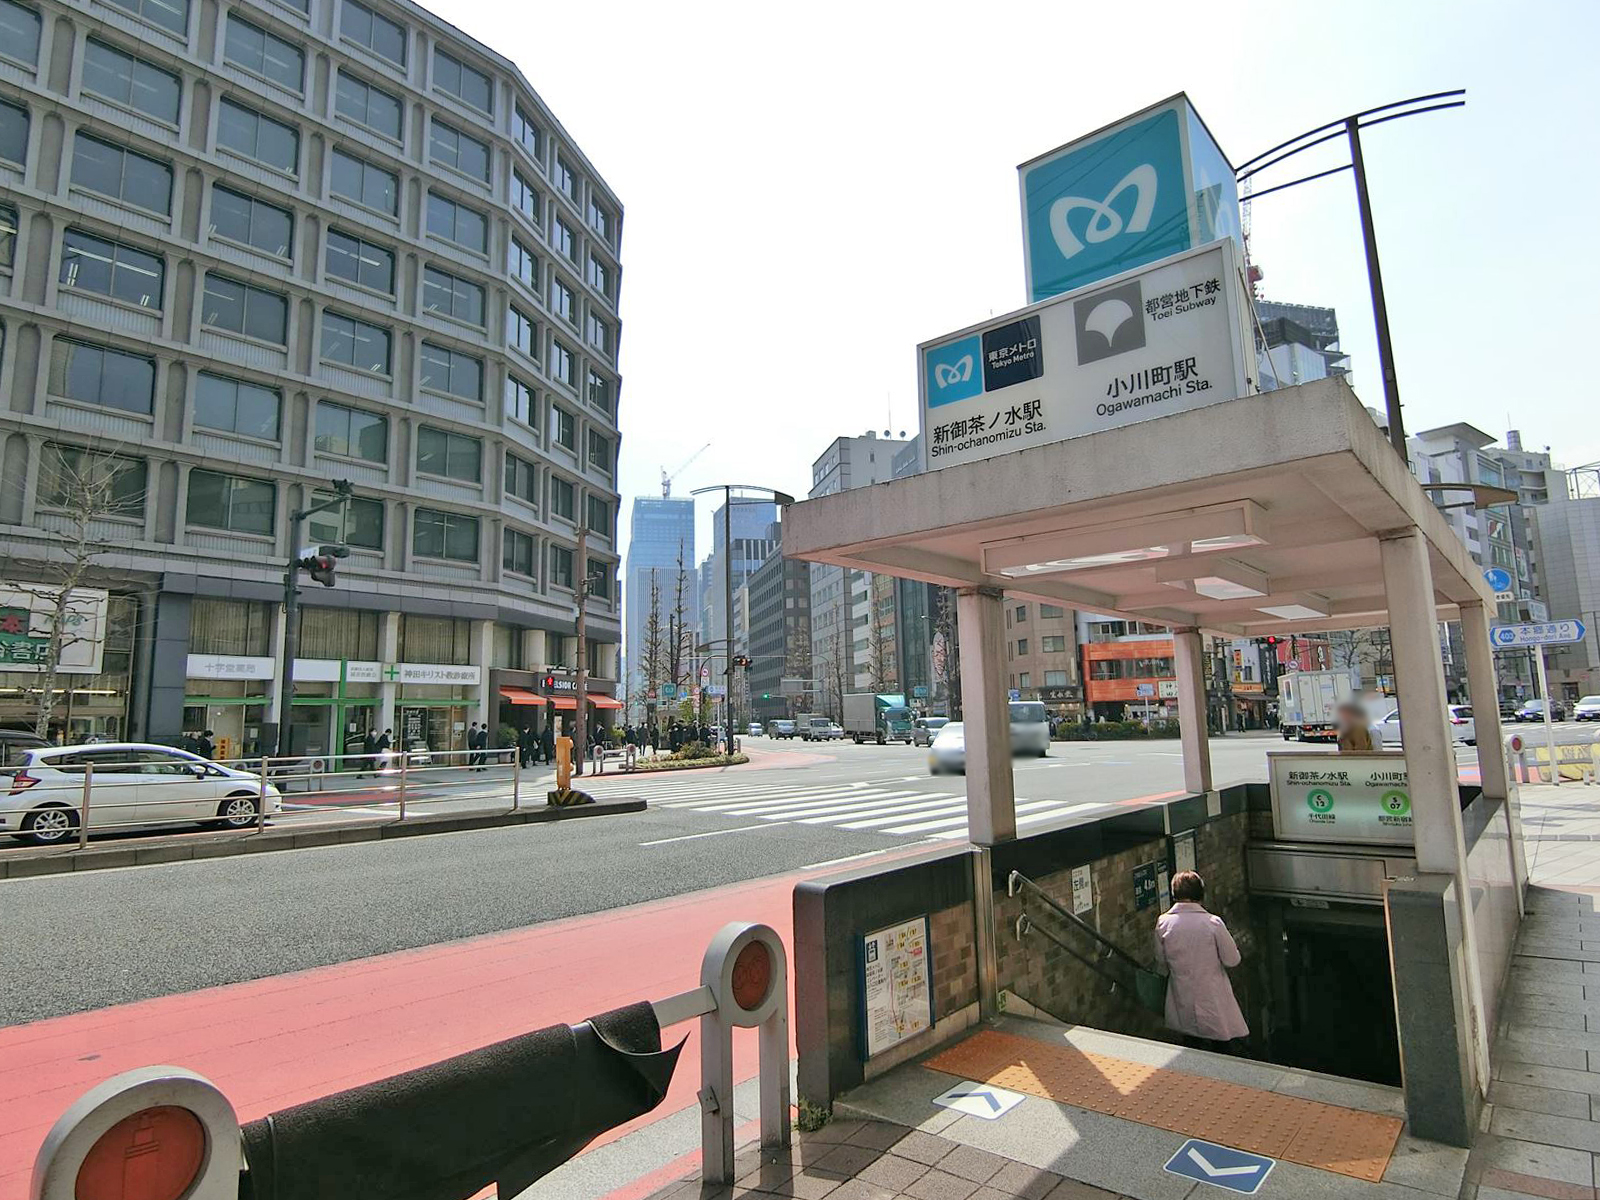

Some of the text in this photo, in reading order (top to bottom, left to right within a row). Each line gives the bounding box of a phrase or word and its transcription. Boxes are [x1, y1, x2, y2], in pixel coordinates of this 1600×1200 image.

[1145, 278, 1221, 314] 都営地下鉄
[1151, 296, 1217, 322] Toei Subway
[988, 338, 1037, 362] 東京メトロ
[991, 350, 1035, 370] Tokyo Metro
[1106, 357, 1198, 398] 小川町駅
[1096, 379, 1213, 417] Ogawamachi Sta.
[933, 399, 1042, 444] 新御茶ノ水駅
[931, 421, 1047, 458] Shin-ochanomizu Sta.
[1520, 623, 1570, 635] 本郷通り
[1288, 771, 1349, 781] 新御茶ノ水駅
